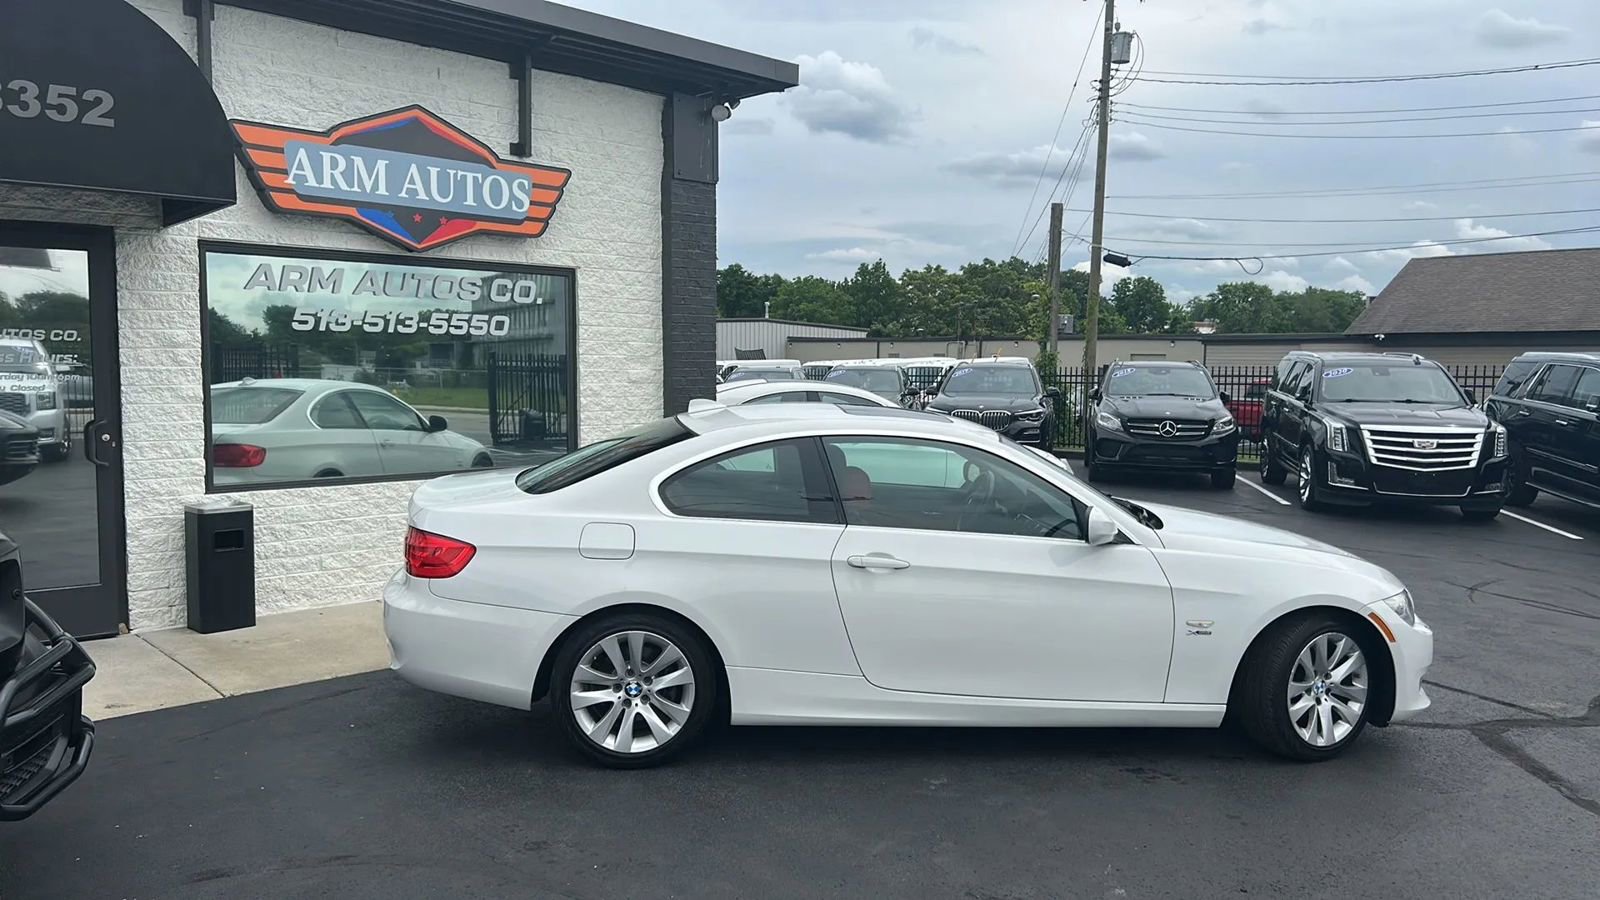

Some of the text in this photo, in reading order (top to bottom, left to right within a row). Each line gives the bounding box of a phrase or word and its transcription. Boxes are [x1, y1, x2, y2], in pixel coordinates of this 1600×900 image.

[0, 80, 115, 128] 352
[284, 147, 530, 213] ARM AUTOS
[244, 263, 543, 305] ARM AUTOS CO.
[50, 330, 82, 341] CO.
[291, 308, 510, 336] 513-513-5550
